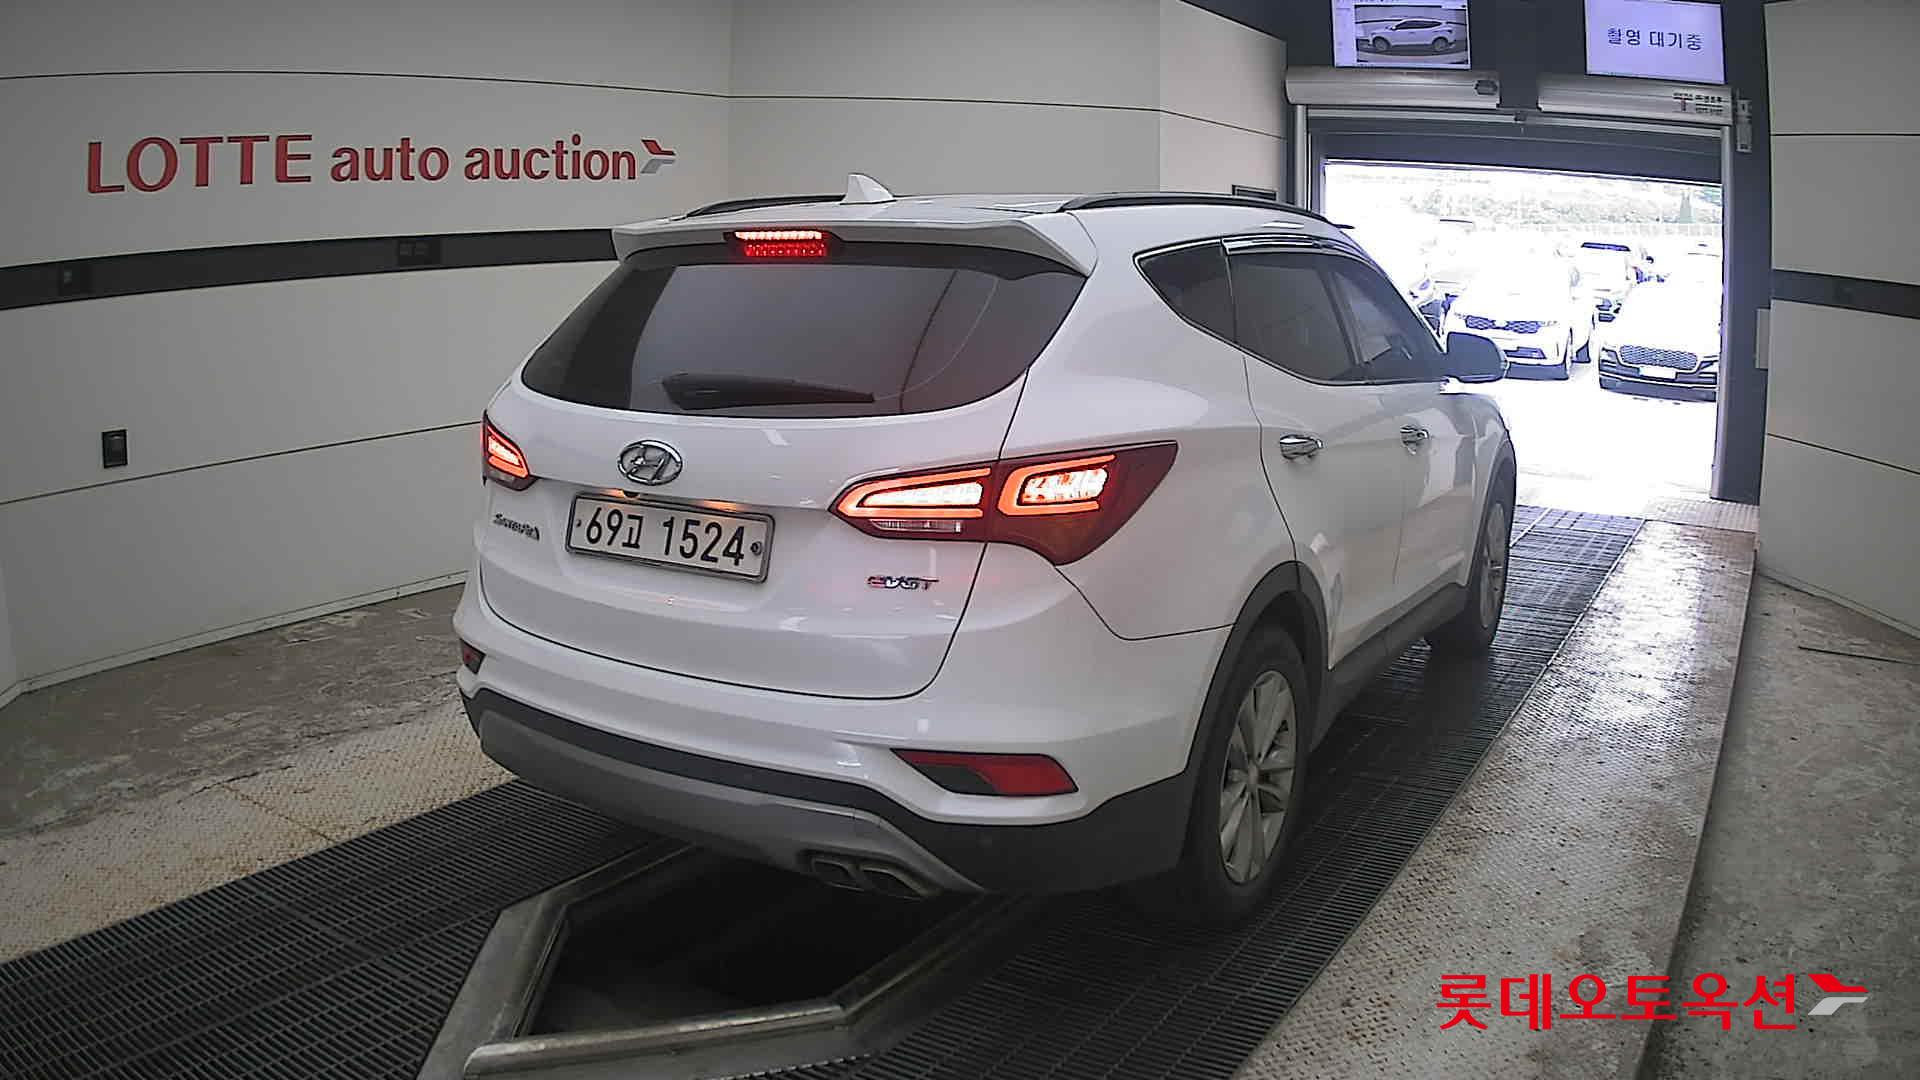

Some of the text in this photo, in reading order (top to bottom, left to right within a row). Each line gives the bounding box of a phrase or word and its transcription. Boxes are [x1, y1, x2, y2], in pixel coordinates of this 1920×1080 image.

[1649, 31, 1702, 51] 대기중
[86, 133, 637, 194] LOTTE auto auction
[586, 506, 644, 550] 69고
[662, 515, 745, 567] 1524
